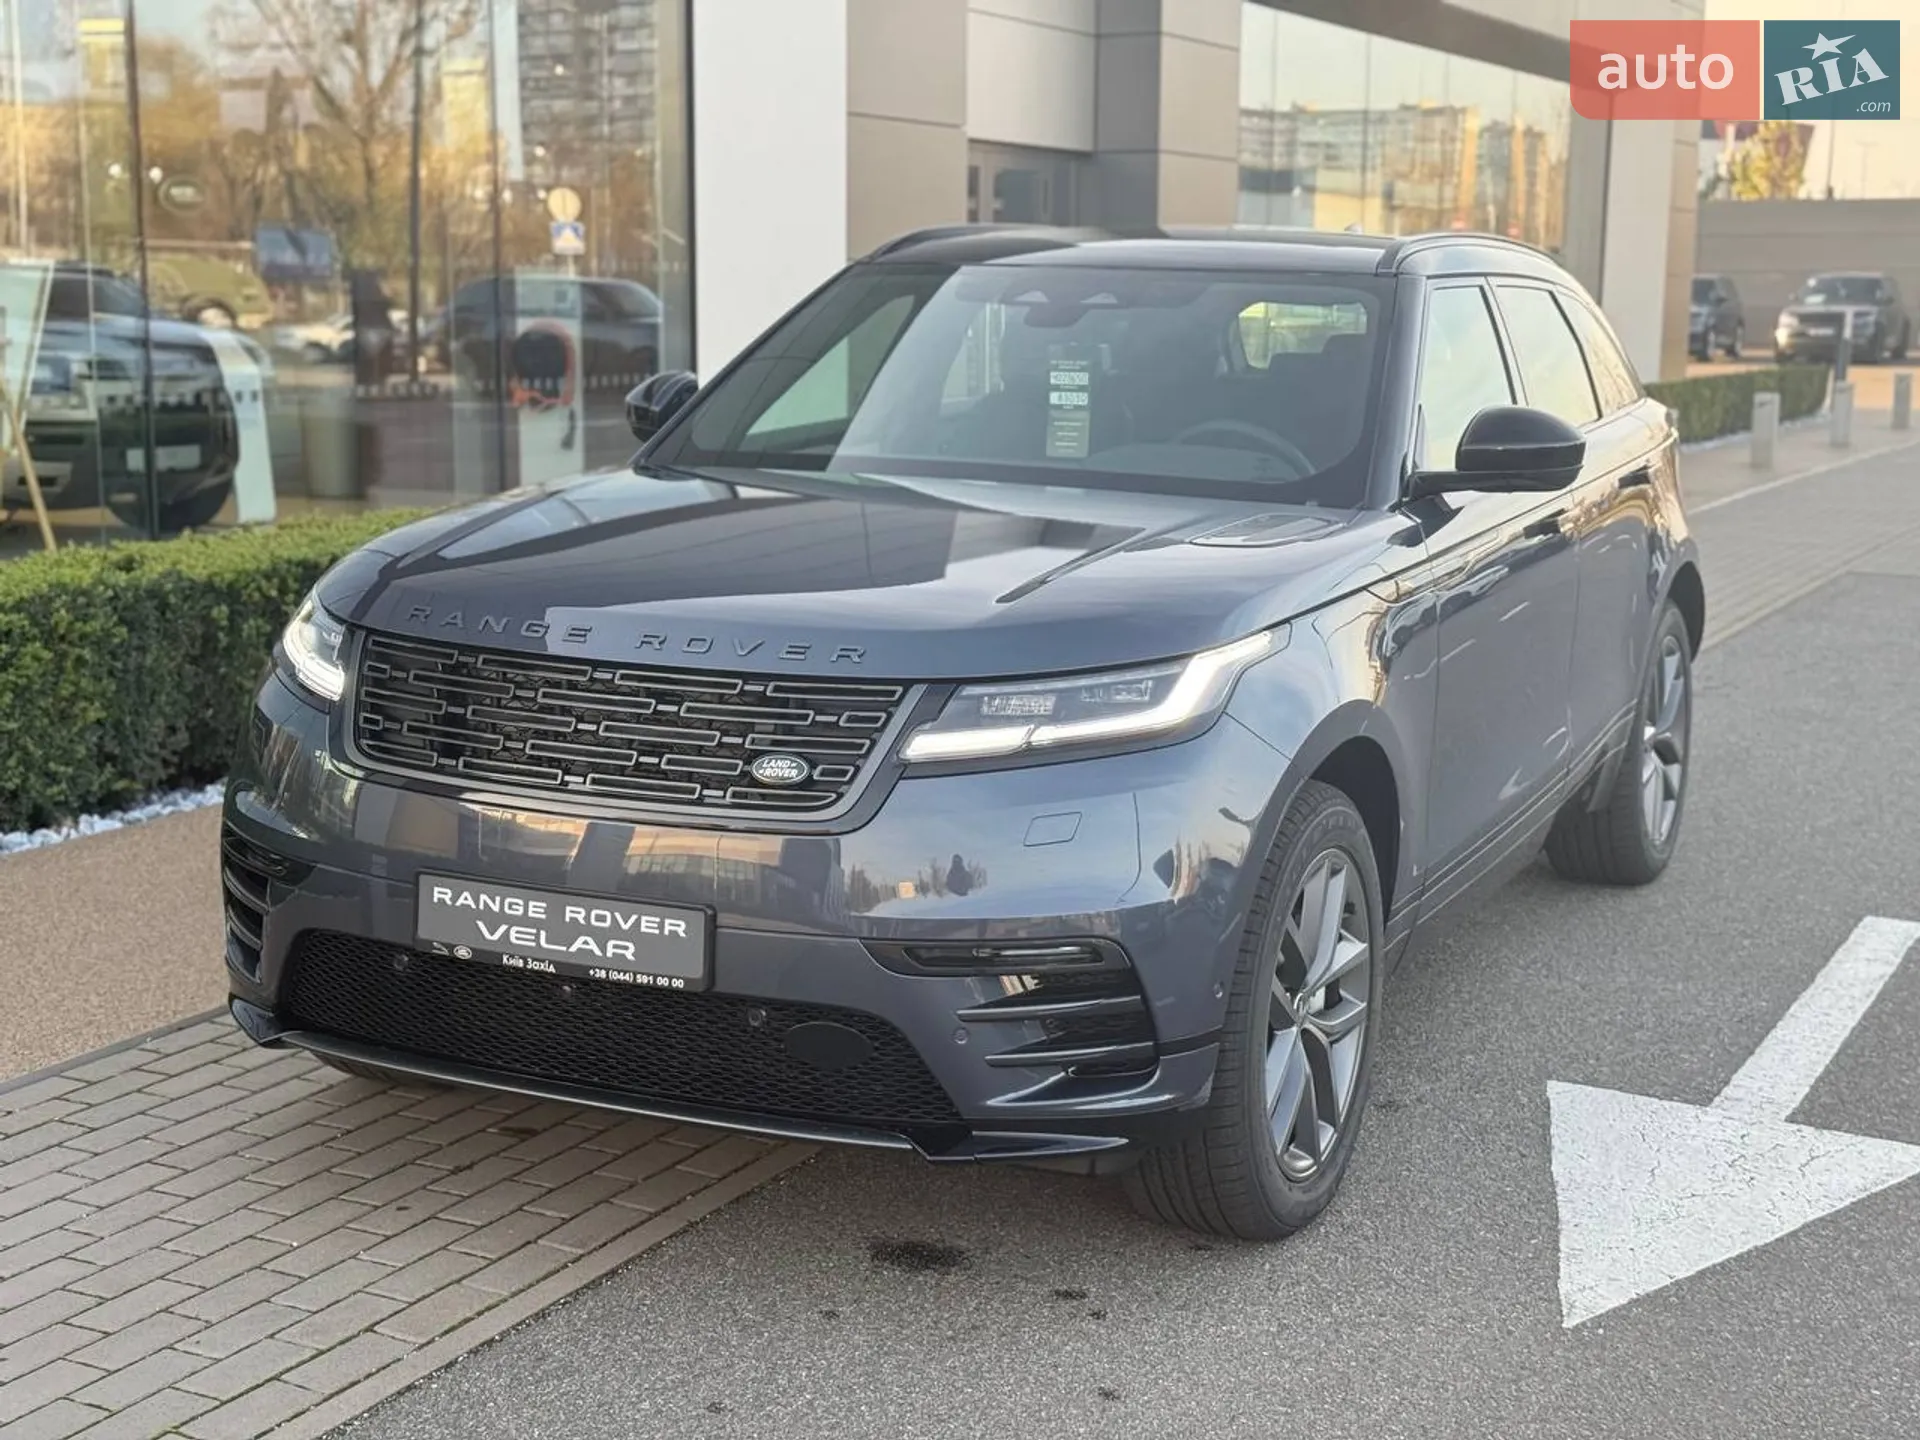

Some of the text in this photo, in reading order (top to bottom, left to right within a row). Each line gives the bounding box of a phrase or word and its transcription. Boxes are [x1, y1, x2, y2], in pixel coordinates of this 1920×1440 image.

[405, 605, 867, 664] RANGE ROVER
[762, 759, 791, 768] LAND
[763, 768, 798, 778] ROVER
[432, 886, 687, 937] RANGE ROVER
[475, 920, 636, 961] VELAR
[502, 953, 524, 968] Київ
[589, 967, 607, 979] +38
[608, 969, 634, 983] (044)
[656, 976, 669, 987] 00
[671, 978, 684, 989] 00
